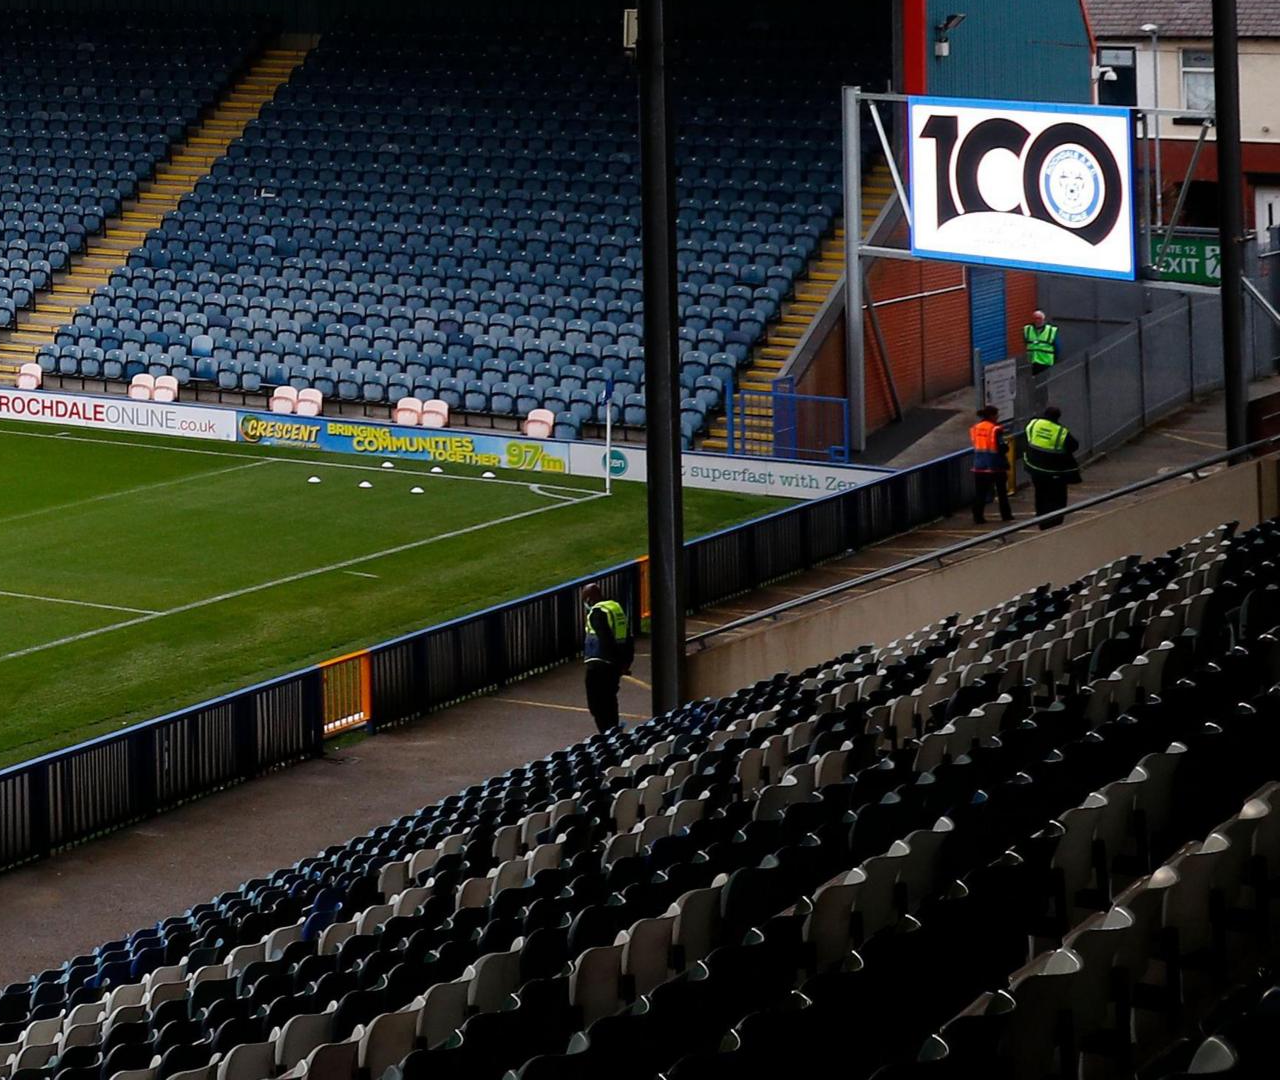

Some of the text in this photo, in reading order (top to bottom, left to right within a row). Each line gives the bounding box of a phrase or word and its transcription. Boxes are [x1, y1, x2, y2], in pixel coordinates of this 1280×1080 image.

[1184, 246, 1198, 256] 12
[247, 419, 321, 443] CRESCENT
[326, 422, 391, 440] BRINGING
[351, 436, 474, 454] COMMUNITIES
[427, 449, 501, 468] TOGETHER
[690, 465, 775, 488] superfast
[779, 471, 820, 490] with
